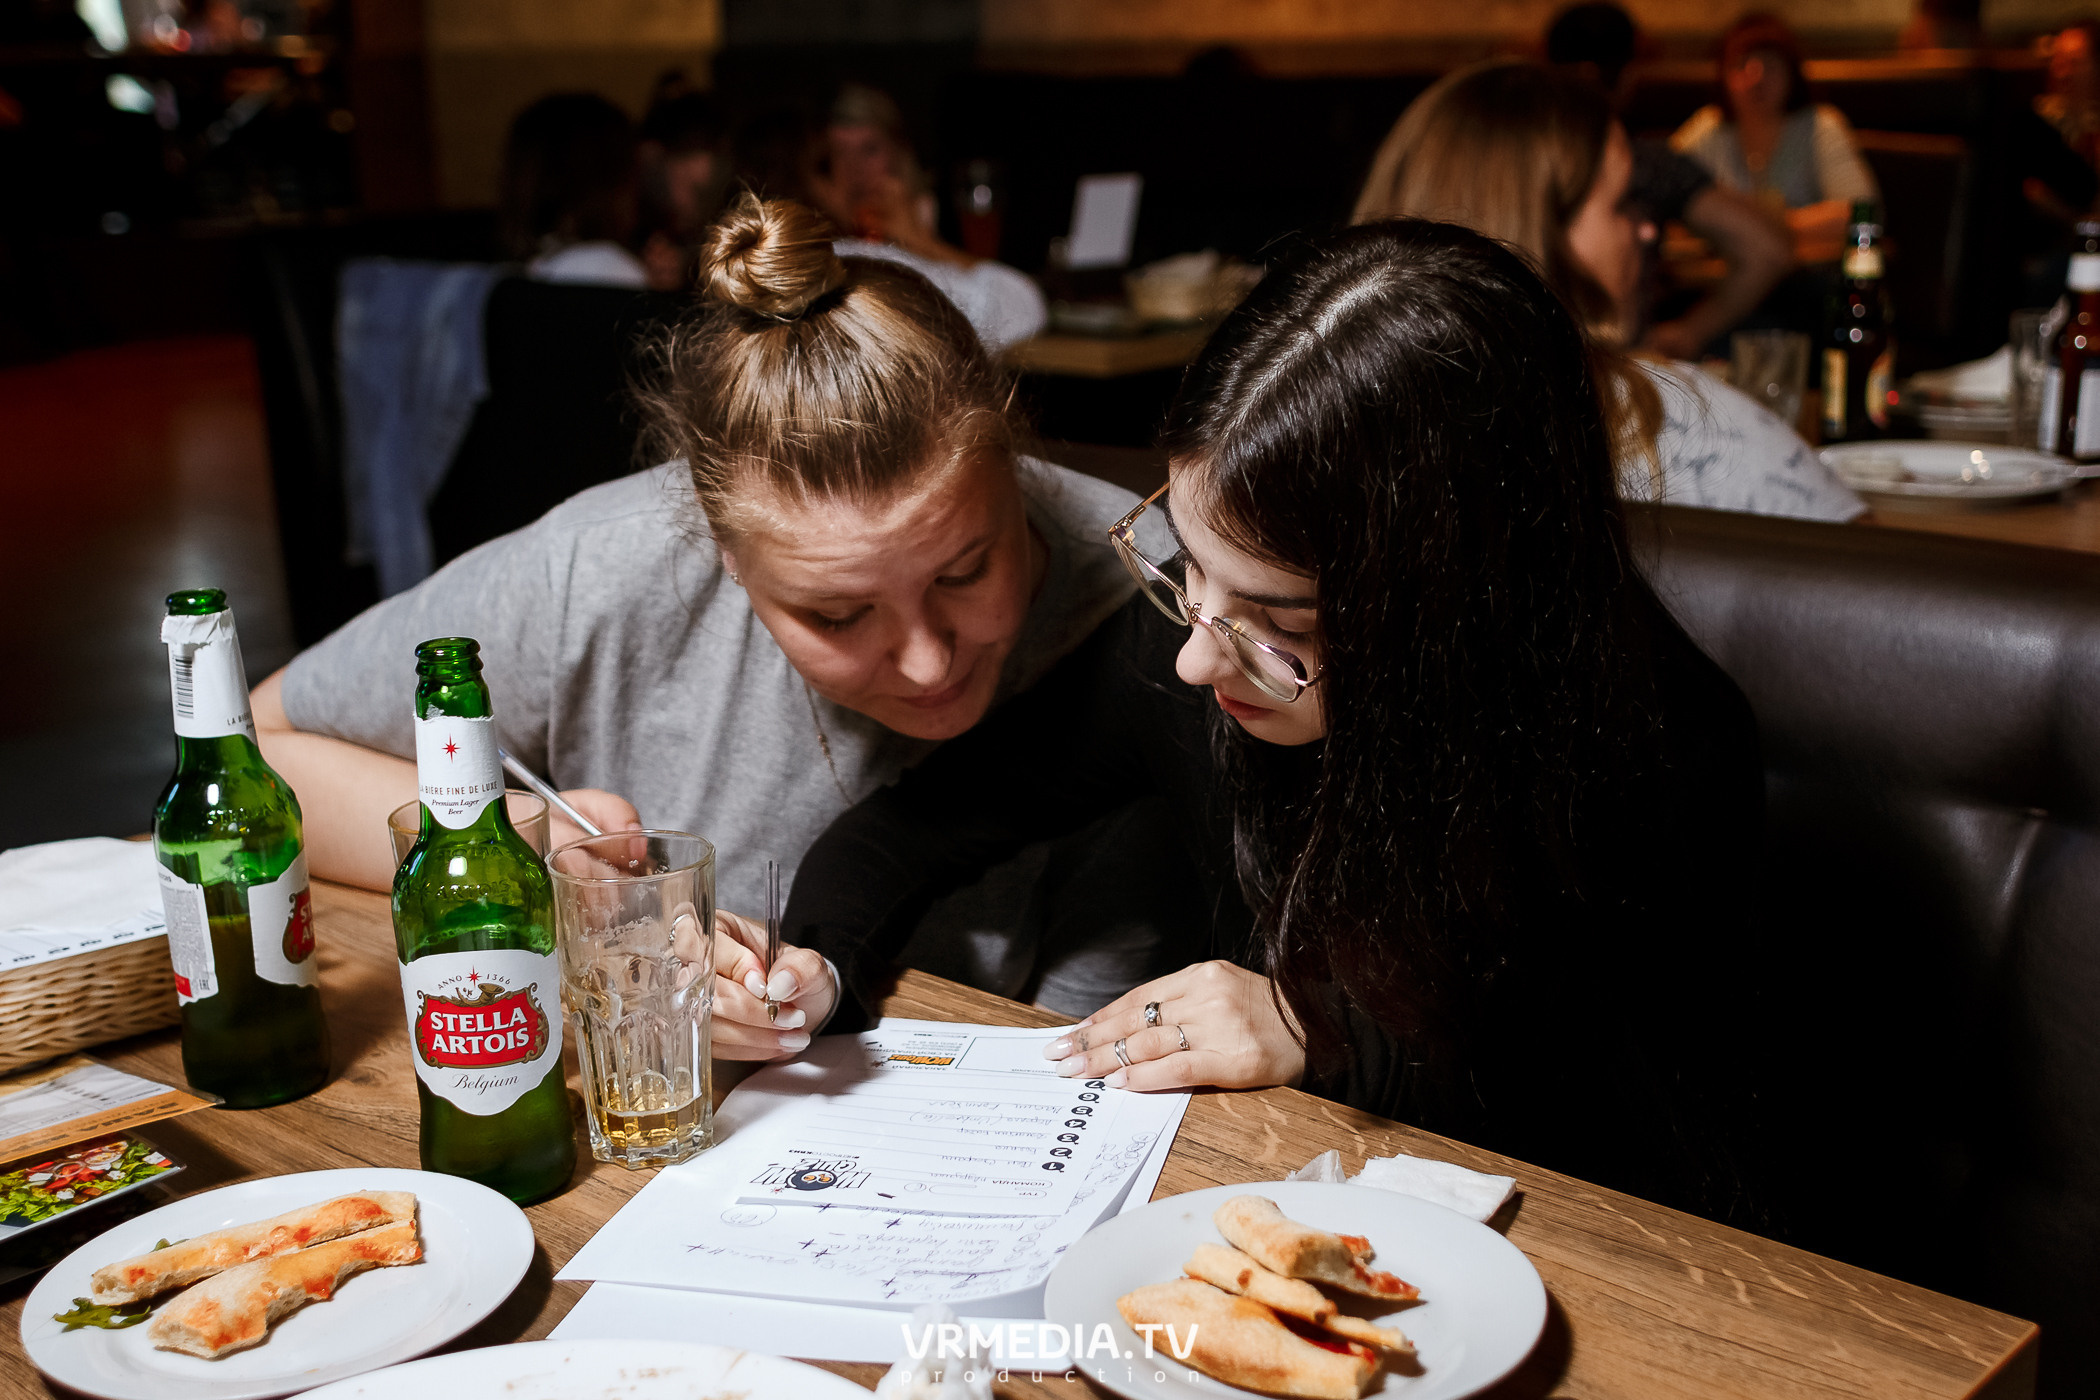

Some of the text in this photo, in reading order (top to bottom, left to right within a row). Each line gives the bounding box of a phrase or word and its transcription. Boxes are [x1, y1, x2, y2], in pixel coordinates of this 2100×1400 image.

[447, 786, 465, 796] FINE
[469, 785, 478, 794] DE
[481, 781, 498, 792] LUXE
[431, 799, 479, 808] Premium Lager
[437, 973, 512, 990] ANNO 1366
[430, 1007, 528, 1033] STELLA
[432, 1027, 530, 1055] ARTOIS
[451, 1073, 520, 1096] Belgium
[1061, 1134, 1075, 1142] 3
[1054, 1148, 1068, 1156] 2
[792, 1159, 857, 1173] QUIZ
[992, 1179, 1046, 1187] КОМАНДА
